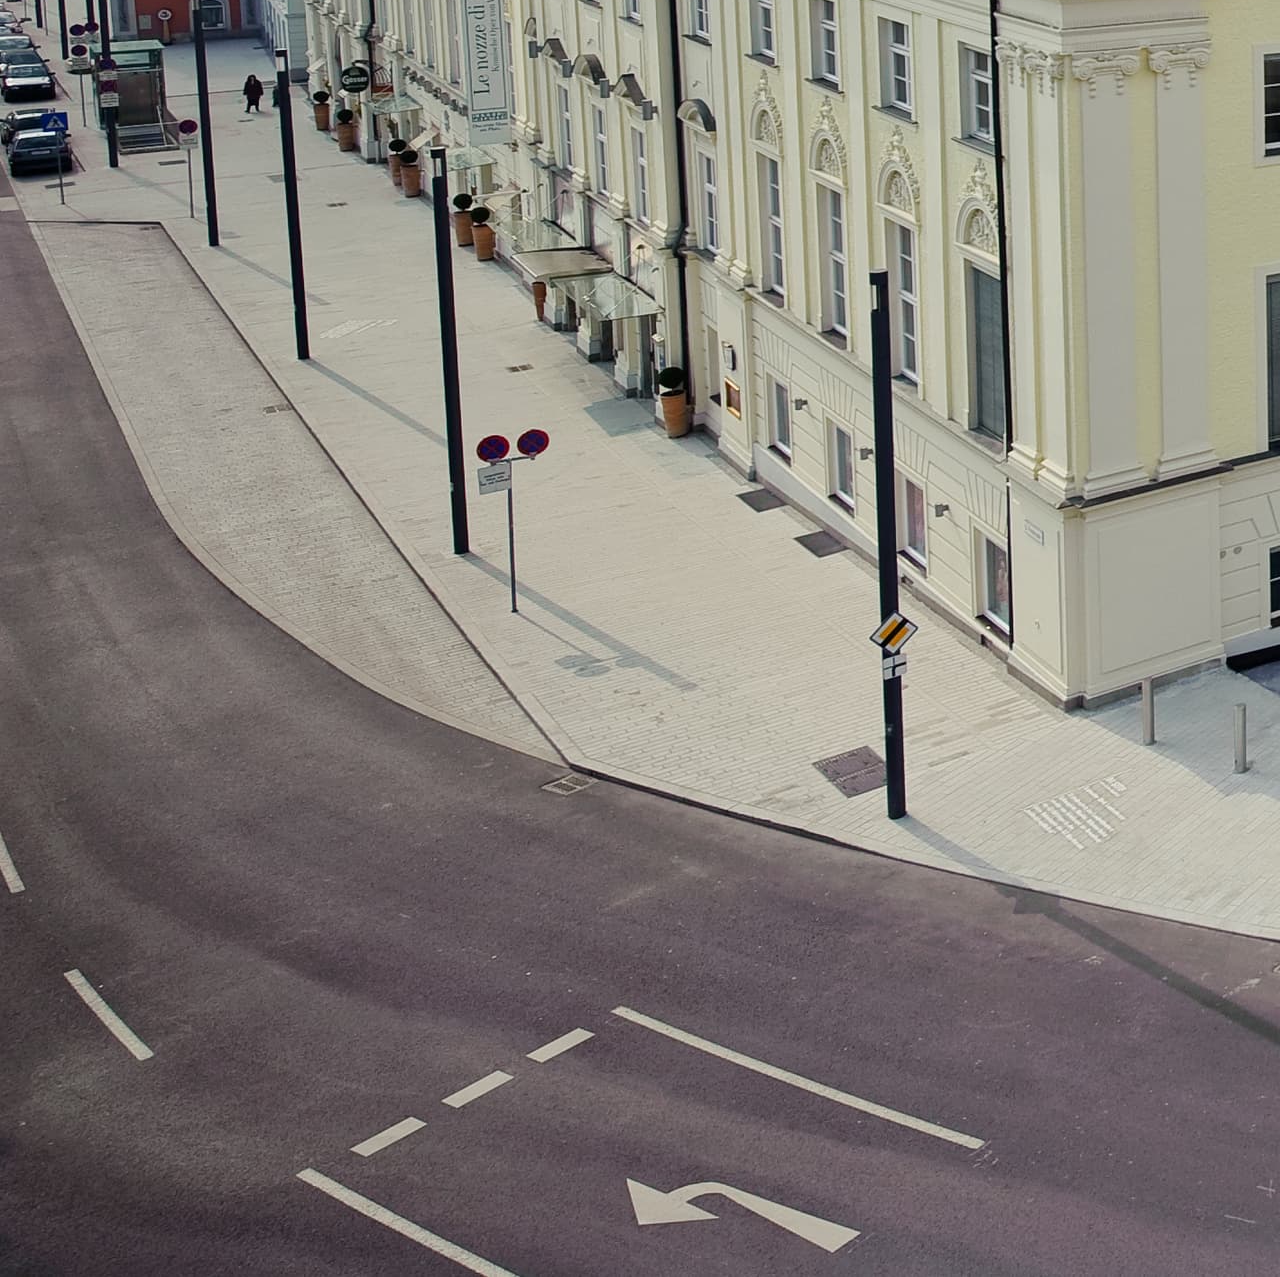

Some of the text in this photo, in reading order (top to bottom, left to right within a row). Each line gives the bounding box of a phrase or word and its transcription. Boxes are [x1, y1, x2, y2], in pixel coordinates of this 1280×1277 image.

[467, 5, 485, 20] di
[474, 25, 488, 69] nozze
[473, 75, 490, 95] Le
